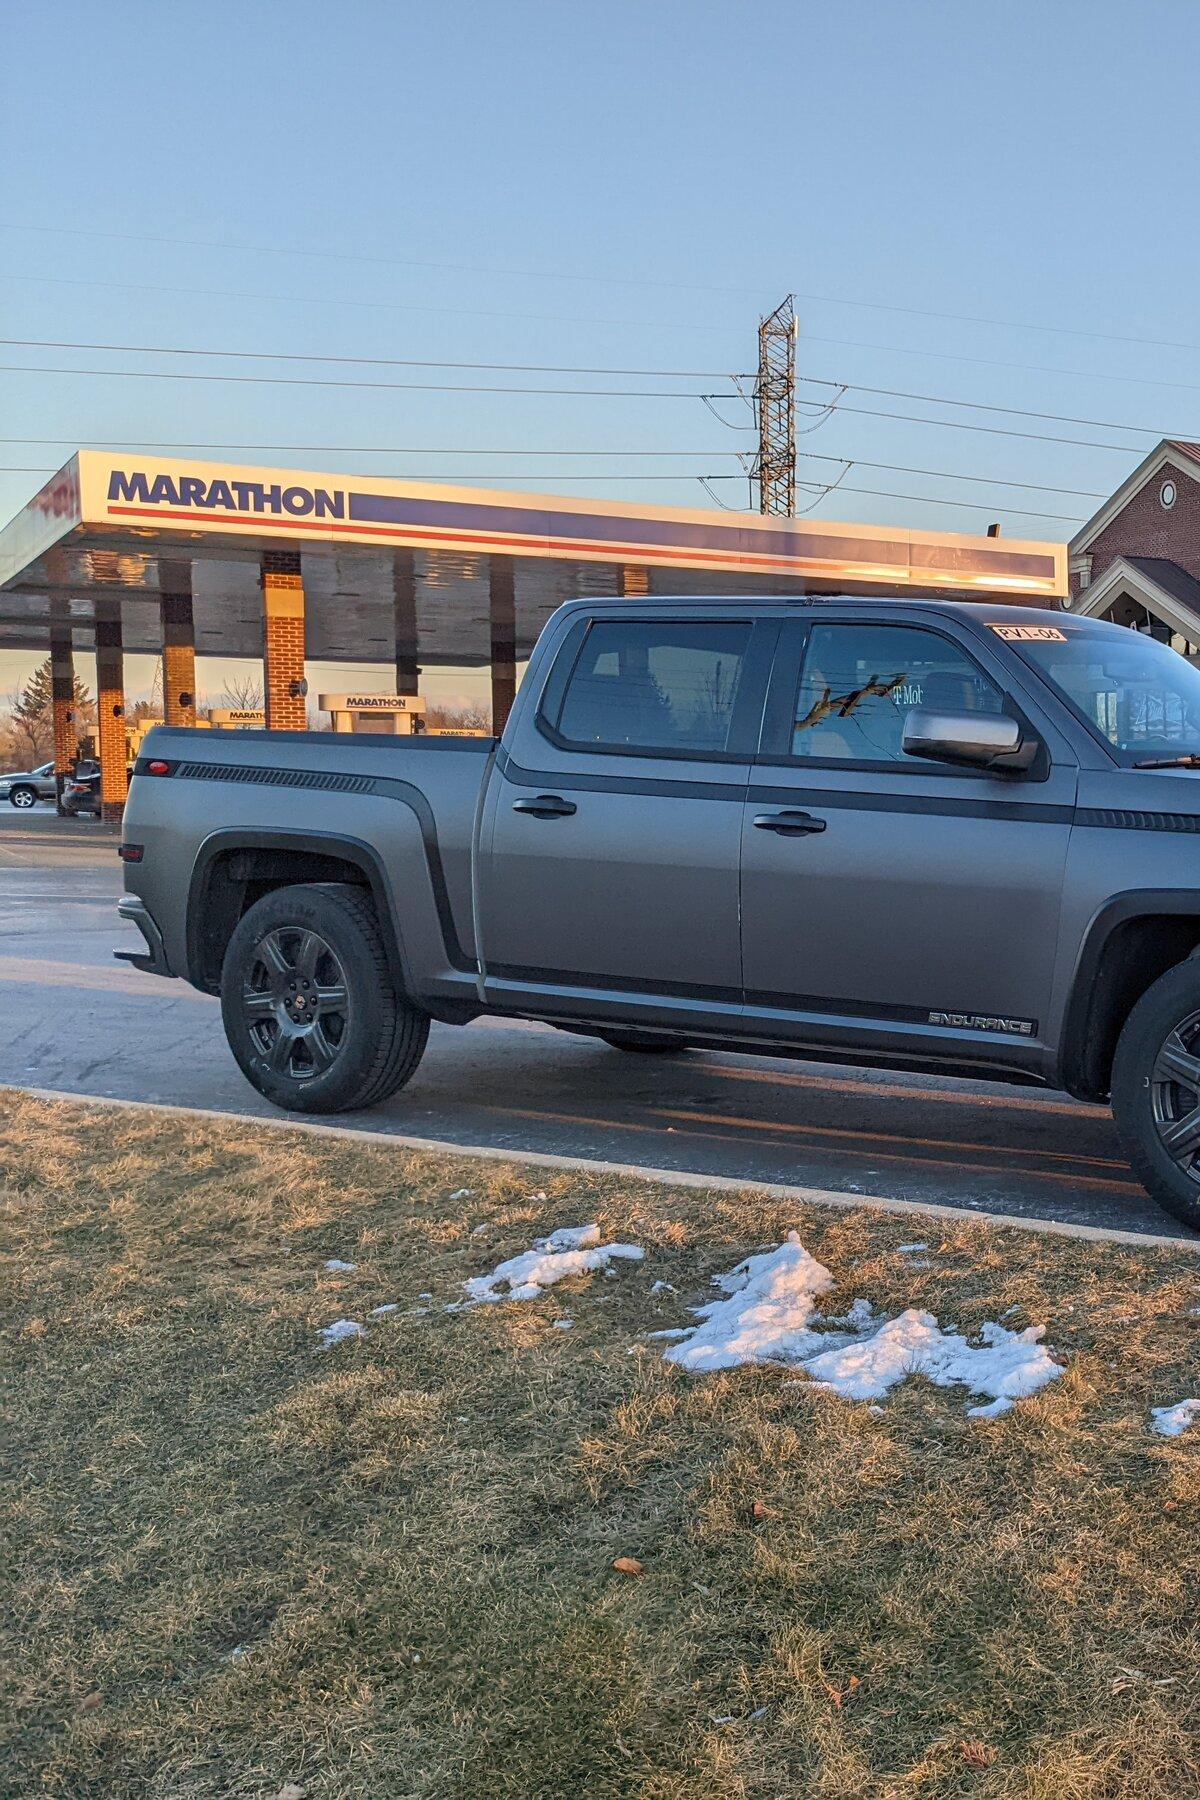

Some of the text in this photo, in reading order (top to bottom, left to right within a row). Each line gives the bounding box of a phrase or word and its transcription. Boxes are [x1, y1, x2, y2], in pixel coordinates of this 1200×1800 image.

[107, 470, 345, 519] MARATHON
[998, 628, 1061, 639] PV1-06
[346, 697, 406, 707] MARATHON
[928, 1011, 1033, 1034] ENDURANCE
